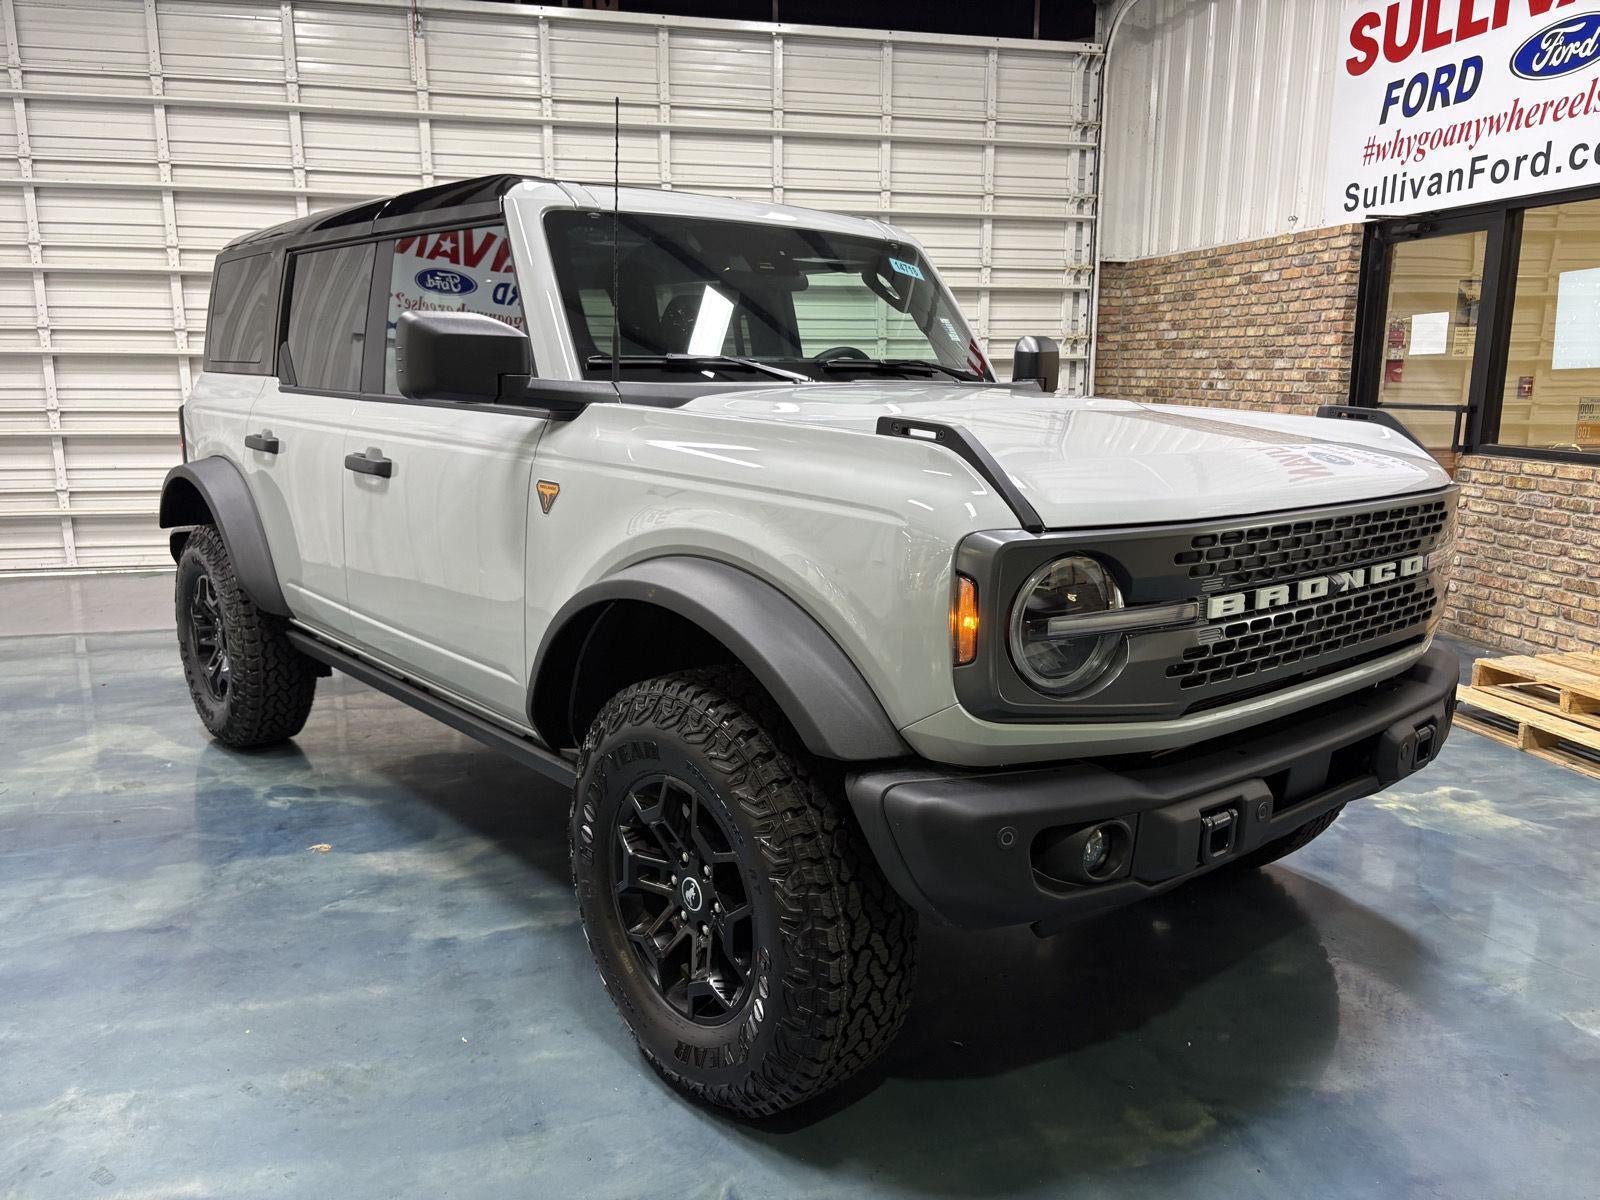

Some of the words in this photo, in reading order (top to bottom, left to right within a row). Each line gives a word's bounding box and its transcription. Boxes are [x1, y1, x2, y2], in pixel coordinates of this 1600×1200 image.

[1532, 22, 1600, 72] Ford
[1379, 55, 1484, 125] FORD
[1207, 555, 1425, 619] BRONCO
